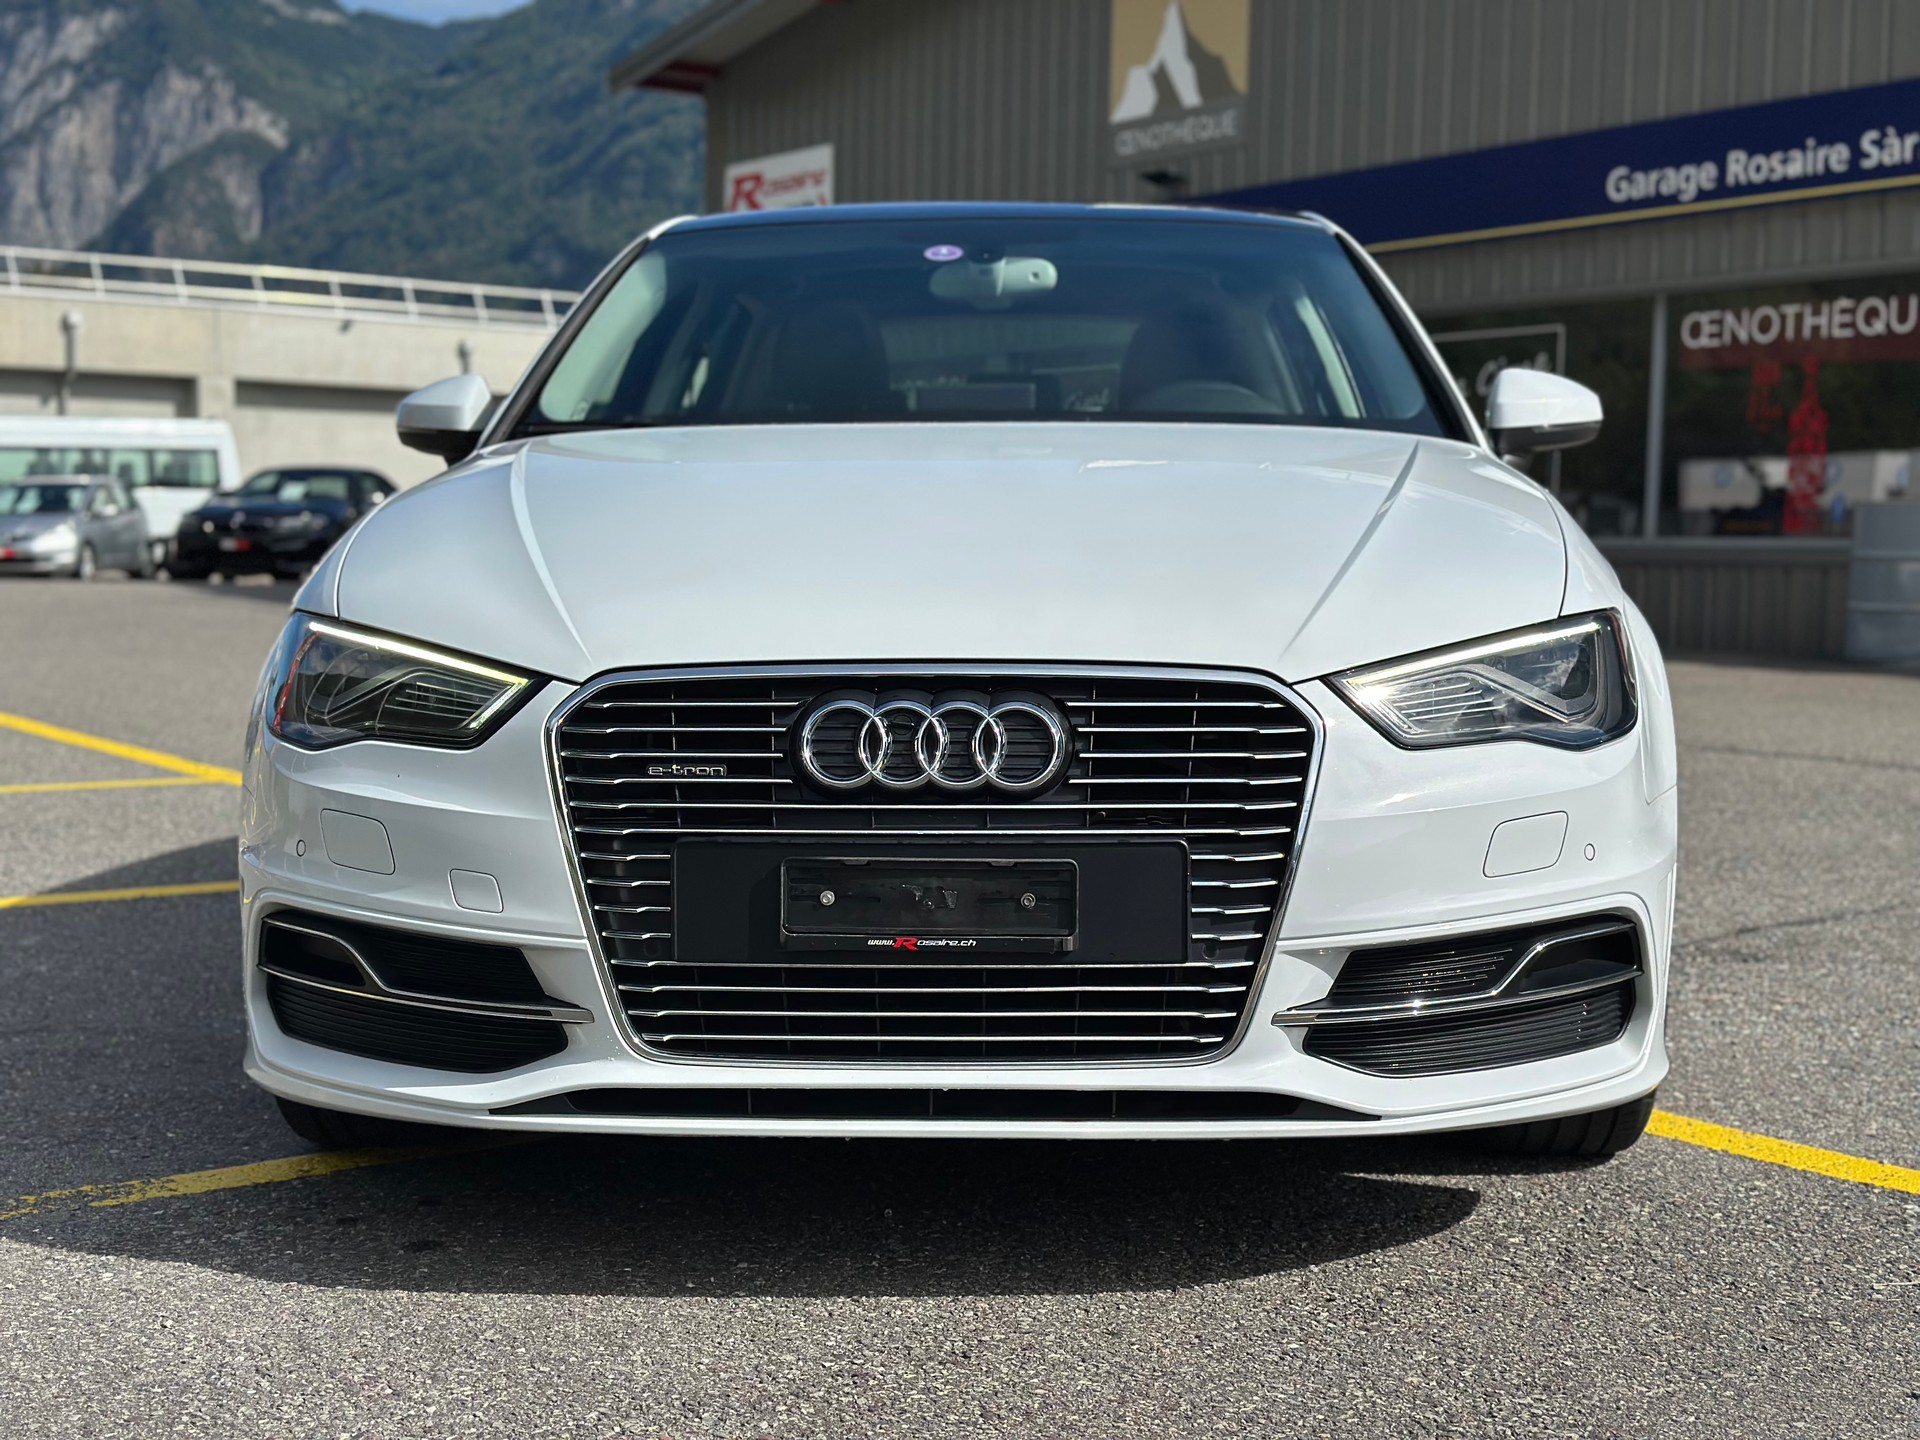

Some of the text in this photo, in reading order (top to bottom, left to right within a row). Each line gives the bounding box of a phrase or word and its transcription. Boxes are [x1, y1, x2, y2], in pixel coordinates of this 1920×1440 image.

[1605, 125, 1920, 203] Garage Rosaire Sàr
[648, 764, 725, 777] e-tron
[867, 937, 977, 951] www.Rosaire.ch
